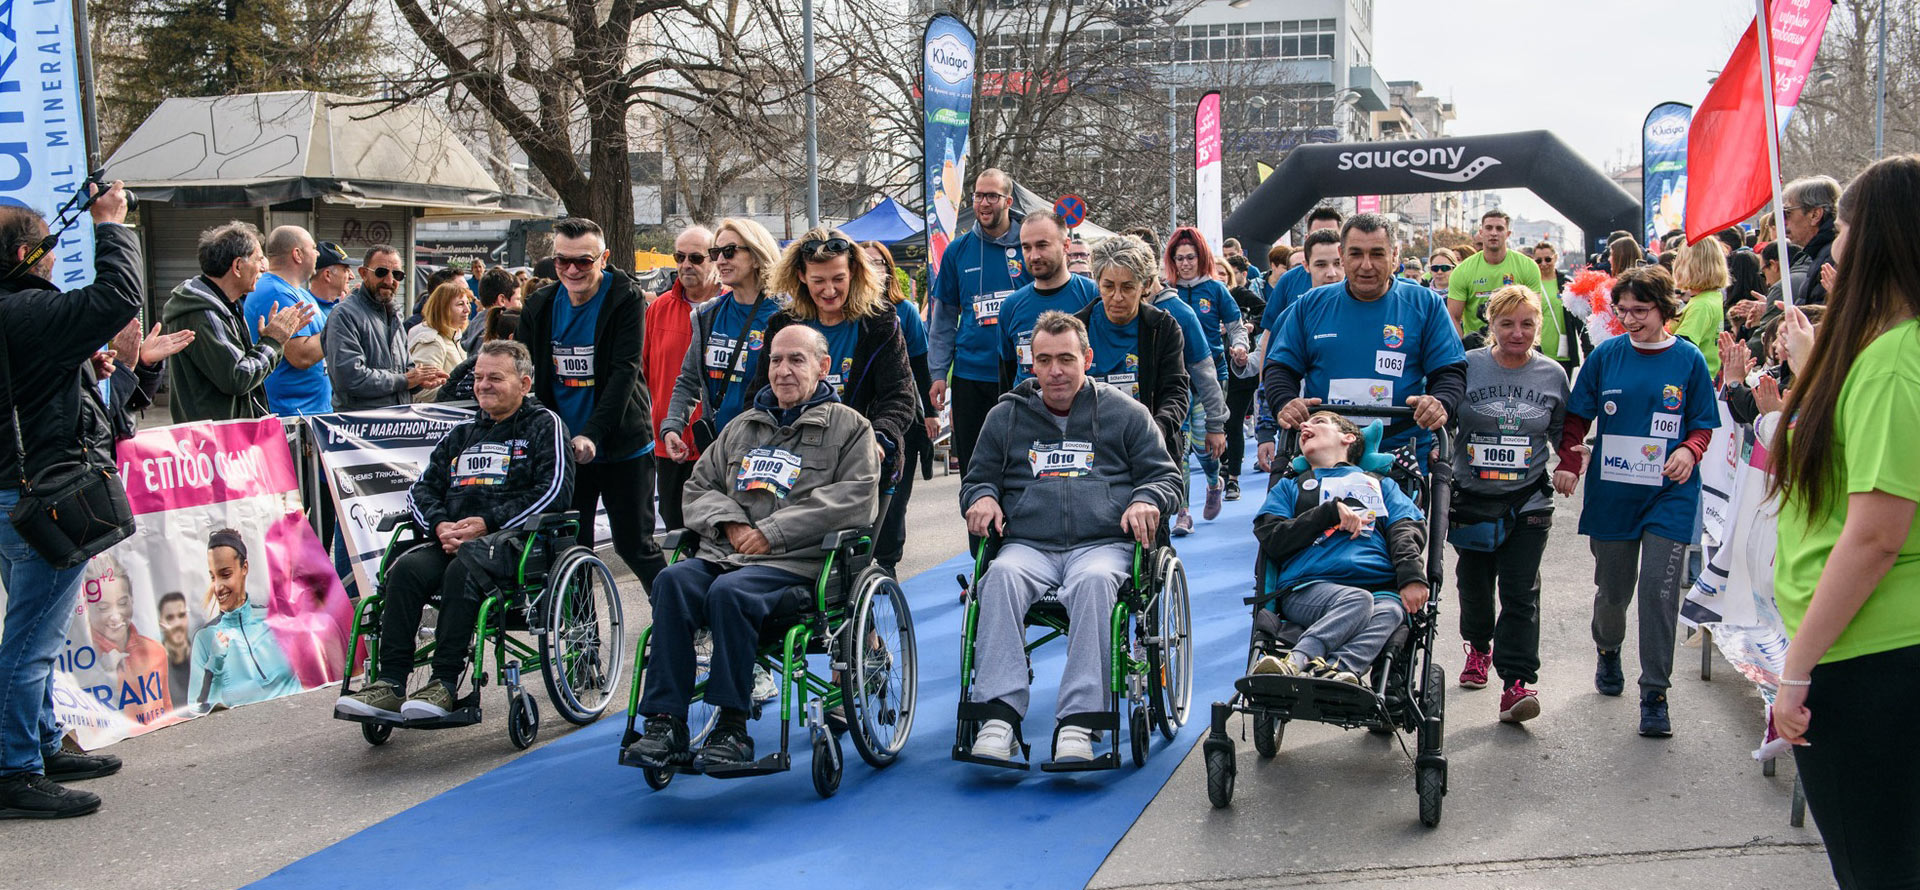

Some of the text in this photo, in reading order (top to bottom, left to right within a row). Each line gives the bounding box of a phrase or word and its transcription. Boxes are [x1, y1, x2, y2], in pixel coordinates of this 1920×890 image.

[36, 24, 69, 147] MINERAL
[1337, 146, 1466, 170] saucony
[51, 165, 85, 283] NATURAL
[26, 247, 45, 265] Nikon
[713, 349, 733, 363] 101
[563, 358, 589, 371] 1003
[1378, 357, 1403, 371] 1063
[1468, 384, 1550, 408] BERLIN AIR
[342, 423, 369, 438] HALF
[369, 420, 428, 436] MARATHON
[1654, 419, 1679, 433] 1061
[483, 445, 507, 453] saucony
[1064, 442, 1091, 450] saucony
[1046, 452, 1076, 465] 1010
[1483, 447, 1516, 463] 1060
[466, 456, 493, 470] 1001
[752, 459, 784, 474] 1009
